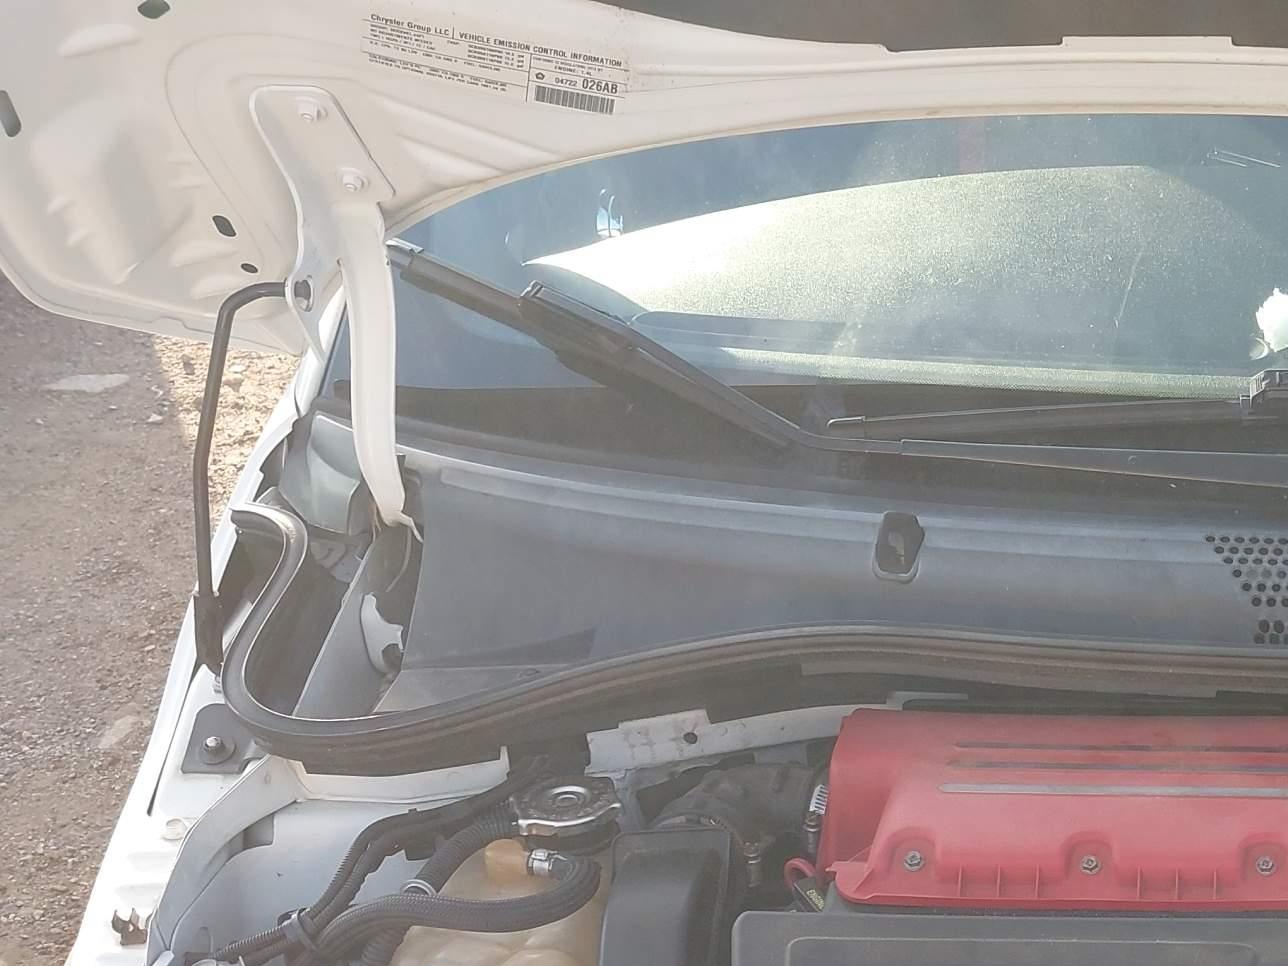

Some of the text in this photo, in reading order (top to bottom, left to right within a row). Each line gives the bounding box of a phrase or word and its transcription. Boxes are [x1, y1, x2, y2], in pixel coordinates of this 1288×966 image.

[370, 13, 450, 36] Chrysler Group LLC
[459, 31, 491, 44] VEHICLE
[493, 37, 531, 52] EMISSION
[533, 45, 568, 59] CONTROL
[570, 52, 622, 68] INFORMATION
[581, 78, 618, 95] 026AB
